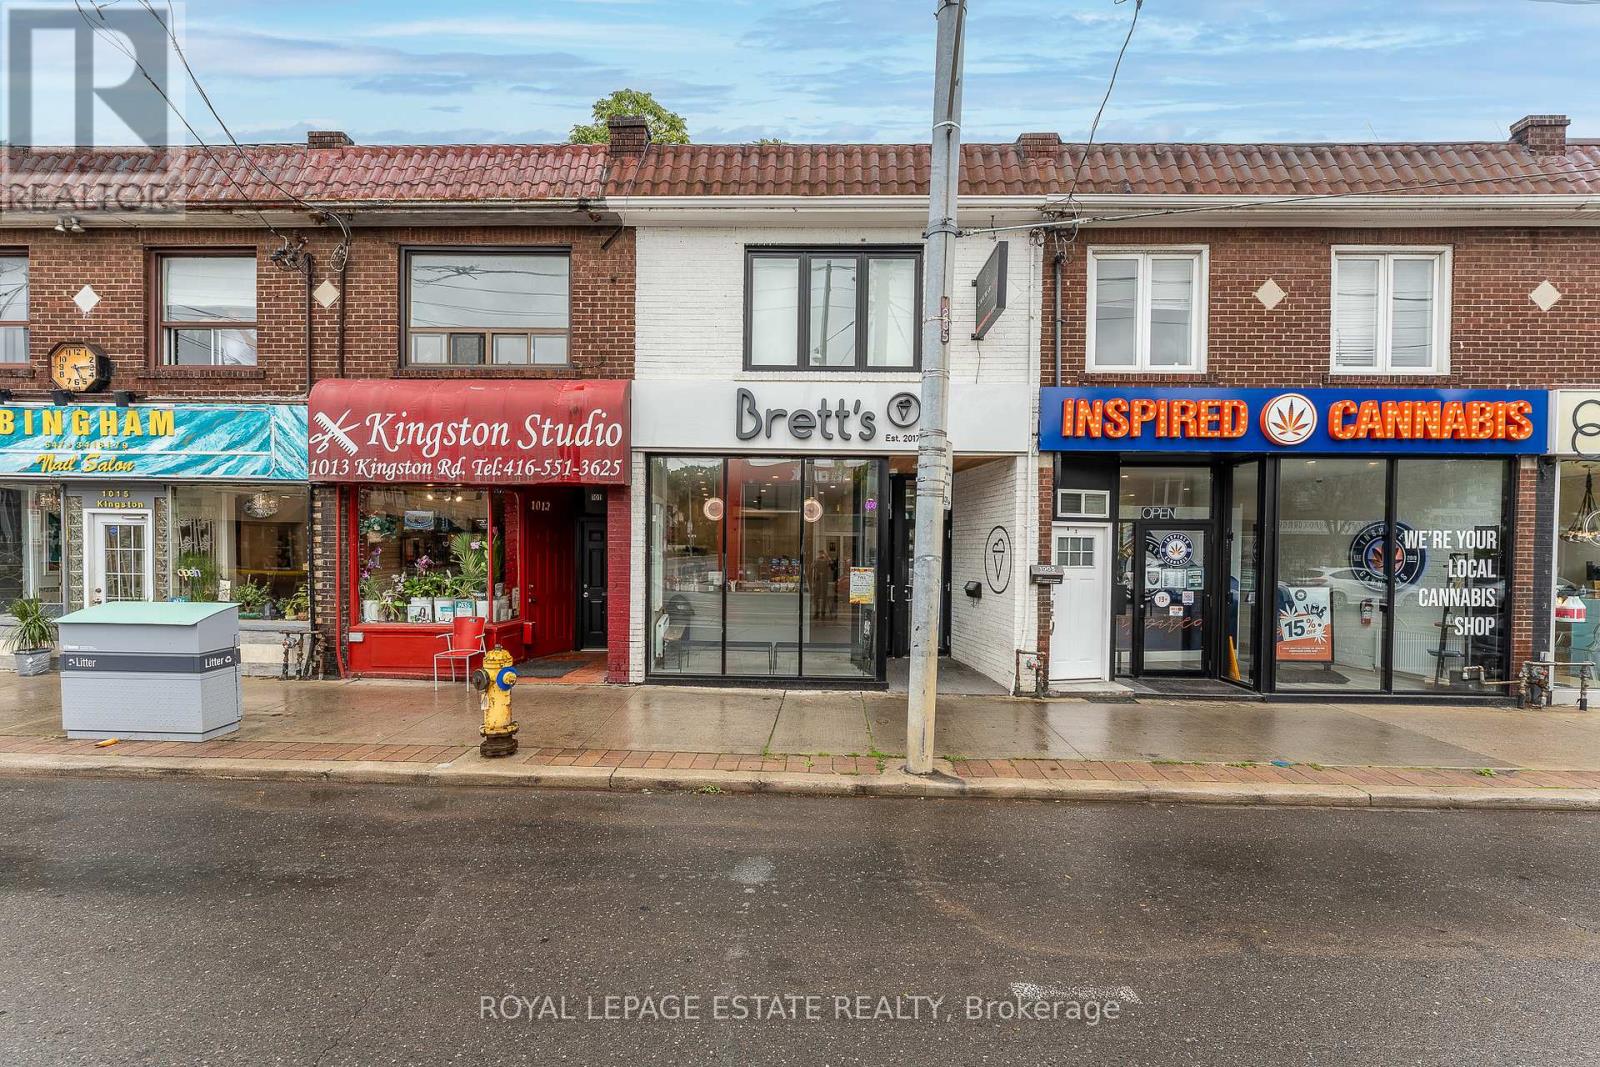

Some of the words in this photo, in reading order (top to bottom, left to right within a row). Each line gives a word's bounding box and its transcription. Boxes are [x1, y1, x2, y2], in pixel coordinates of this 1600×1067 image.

[0, 409, 175, 436] BINGHAM
[736, 387, 876, 441] Brett's
[1061, 397, 1248, 439] INSPIRED
[1328, 399, 1534, 441] CANNABIS
[365, 411, 510, 458] Kingston
[517, 408, 623, 450] Studio
[885, 434, 901, 443] Est.
[903, 434, 920, 443] 2017
[36, 453, 77, 473] Nail
[81, 453, 136, 473] Salon
[309, 459, 349, 476] 1013
[354, 457, 433, 480] Kingston
[438, 456, 466, 478] Rd.
[96, 500, 144, 509] Kingston
[1142, 508, 1177, 519] OPEN
[1404, 530, 1452, 549] WE'RE
[1457, 530, 1497, 549] YOUR
[177, 566, 201, 581] open
[1448, 559, 1497, 578] LOCAL
[1418, 587, 1497, 607] CANNABIS
[1454, 616, 1495, 636] SHOP
[76, 657, 96, 668] Litter
[205, 655, 224, 669] Litter
